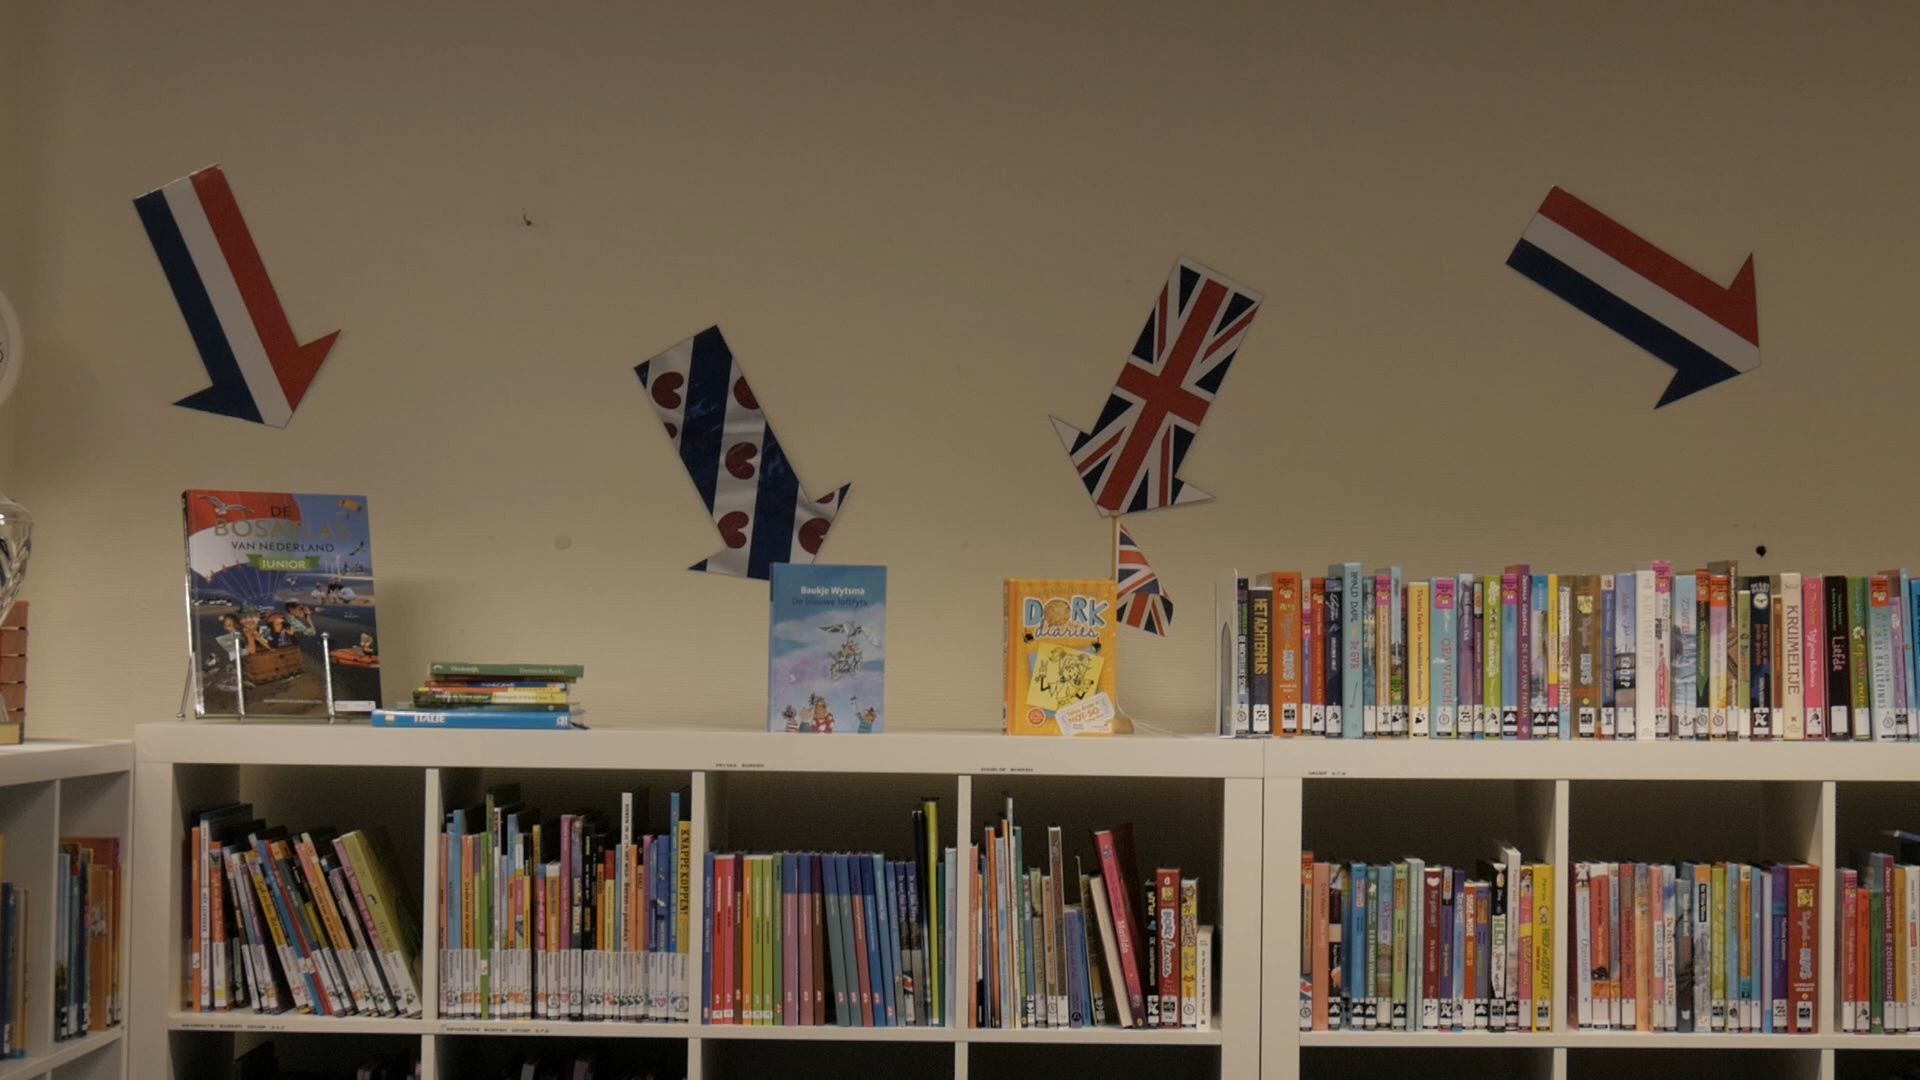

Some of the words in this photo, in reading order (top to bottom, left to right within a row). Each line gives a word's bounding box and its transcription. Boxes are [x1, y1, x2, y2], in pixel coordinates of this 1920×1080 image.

[271, 505, 291, 517] DE
[215, 517, 353, 540] BOSATLAS
[232, 542, 256, 551] VAN
[259, 542, 334, 552] NEDERLAND
[262, 559, 306, 568] JUNIOR
[801, 586, 829, 596] Baukje
[831, 587, 865, 596] Wytsma
[1350, 571, 1358, 598] ROALD
[1023, 595, 1109, 628] DORK
[1254, 599, 1267, 616] HET
[1035, 619, 1100, 640] diaries
[1254, 618, 1268, 674] ACHTERHUIS
[1787, 606, 1799, 694] KRUIMELTJE
[1832, 636, 1845, 672] Liefde
[680, 830, 689, 870] KNAPPE
[680, 872, 688, 915] KOPPEN!
[1161, 909, 1175, 937] DORK
[1116, 920, 1129, 954] Matilda
[1886, 933, 1892, 944] DE
